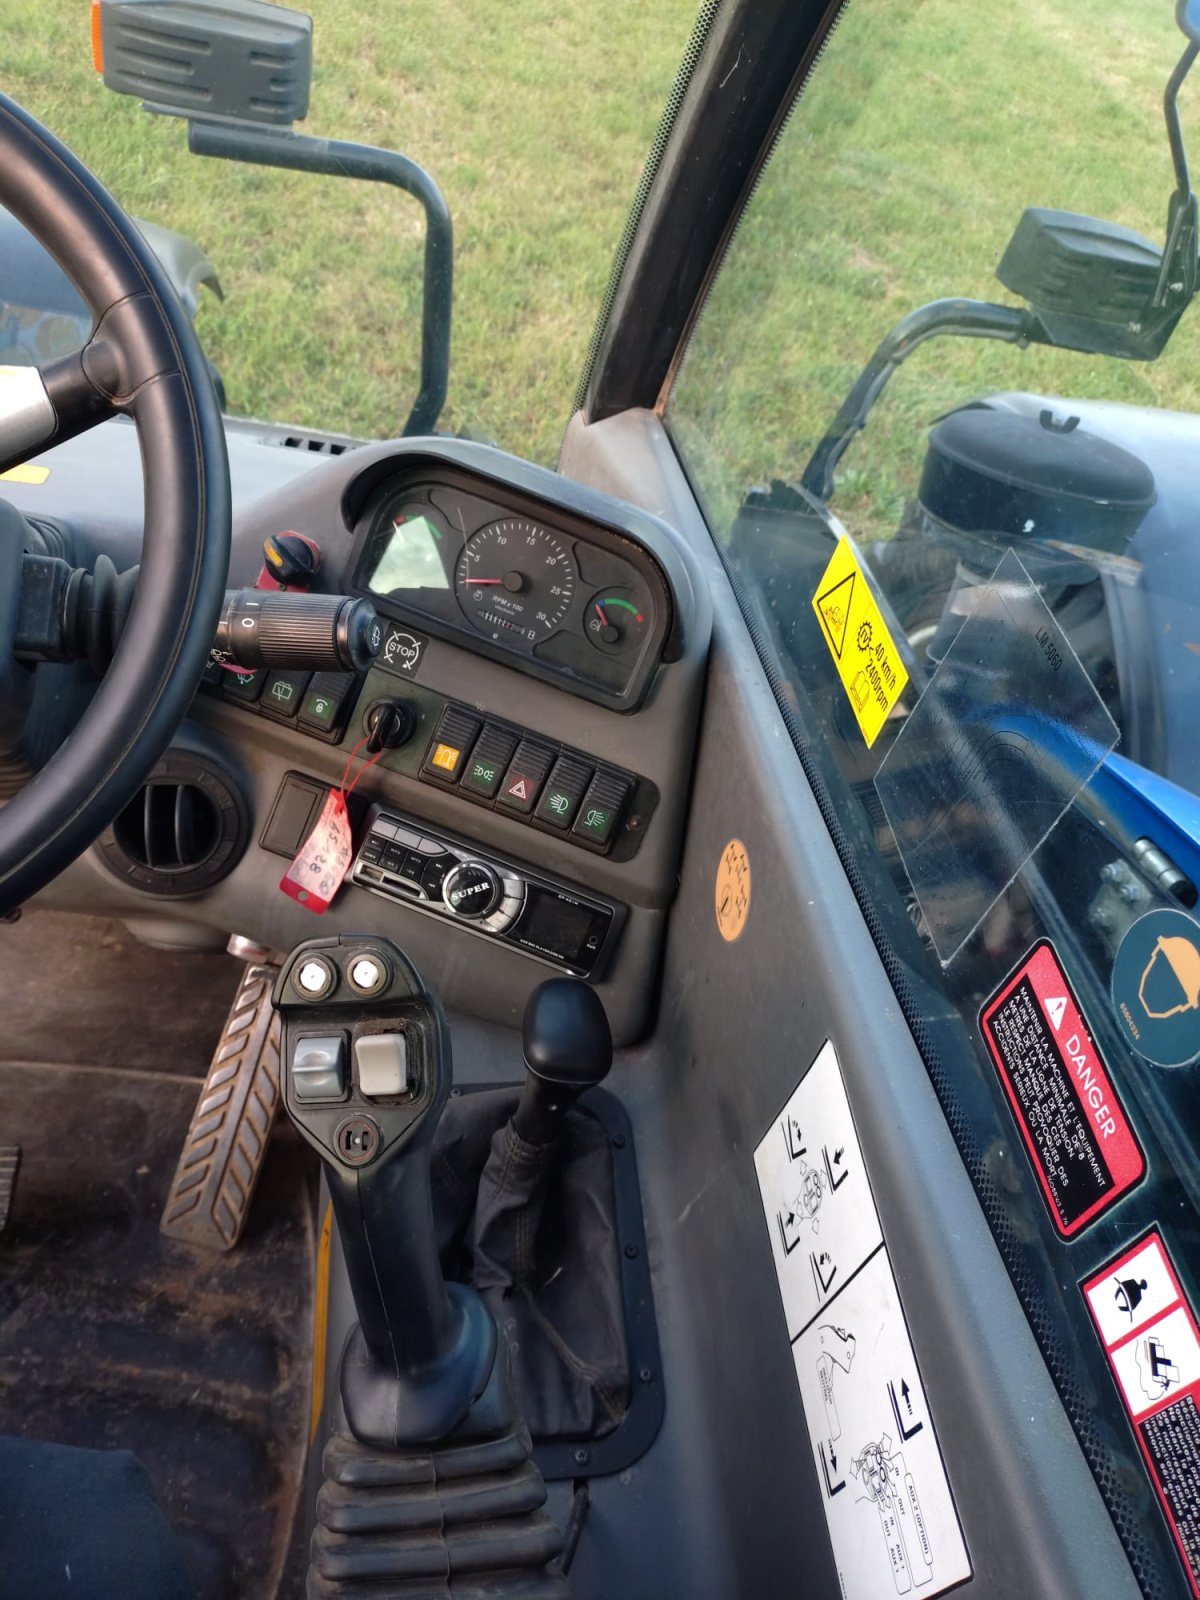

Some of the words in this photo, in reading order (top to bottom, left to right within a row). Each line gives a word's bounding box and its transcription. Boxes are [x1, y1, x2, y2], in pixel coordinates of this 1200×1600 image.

[498, 536, 507, 545] 10
[526, 536, 536, 546] 15
[546, 556, 556, 566] 20
[492, 595, 508, 604] RPM
[512, 604, 523, 612] 100
[536, 612, 546, 620] 30
[550, 586, 560, 595] 25
[389, 642, 416, 658] STOP
[875, 642, 884, 662] 40
[881, 656, 896, 691] km/h
[1045, 643, 1063, 671] 5060
[866, 658, 888, 712] 2400rpm
[451, 882, 490, 900] SUPER
[993, 1020, 1015, 1069] ACCIDENTS
[1013, 1071, 1030, 1108] SERIEUX
[1028, 1111, 1037, 1127] OU
[1035, 1130, 1043, 1144] LA
[1042, 1147, 1057, 1180] MORT.
[998, 1012, 1025, 1074] INSTRUCTIONS
[1023, 1076, 1035, 1097] PEUT
[1032, 1100, 1059, 1163] PROVOQUER
[1057, 1166, 1068, 1186] DES
[1003, 1006, 1010, 1017] LE
[1008, 1018, 1026, 1055] RESPECT
[1024, 1057, 1044, 1101] MANQUE
[1041, 1103, 1052, 1122] DES
[1050, 1126, 1061, 1146] CES
[1009, 1000, 1024, 1032] METRES
[1022, 1034, 1031, 1048] DE
[1028, 1050, 1036, 1065] LA
[1035, 1066, 1050, 1095] LIGNE
[1047, 1097, 1056, 1112] DE
[1054, 1113, 1074, 1159] TENSION.
[1019, 1004, 1029, 1023] UNE
[1027, 1024, 1048, 1070] DISTANCE
[1048, 1077, 1071, 1126] MINIMALE
[1071, 1134, 1080, 1149] DE
[1020, 986, 1042, 1034] MAINTENIR
[1040, 1036, 1048, 1051] LA
[1045, 1052, 1069, 1099] MACHINE
[1067, 1101, 1075, 1112] ET
[1071, 1116, 1105, 1186] L'EQUIPEMENT
[1065, 1034, 1115, 1138] DANGER
[1150, 1417, 1176, 1480] instructions
[1174, 1485, 1188, 1509] peut
[1160, 1411, 1182, 1454] pendant
[1180, 1458, 1187, 1468] le
[1168, 1407, 1176, 1421] Ne
[1190, 1466, 1200, 1486] pas
[1144, 1420, 1160, 1458] lésions
[1160, 1463, 1183, 1516] sérieuses
[1182, 1521, 1190, 1534] ou
[1189, 1539, 1195, 1549] la
[1162, 1431, 1192, 1498] non-respect
[1190, 1504, 1198, 1517] de
[908, 1485, 916, 1502] AUX
[916, 1514, 929, 1554] (OPTION)
[896, 1544, 904, 1561] AUX
